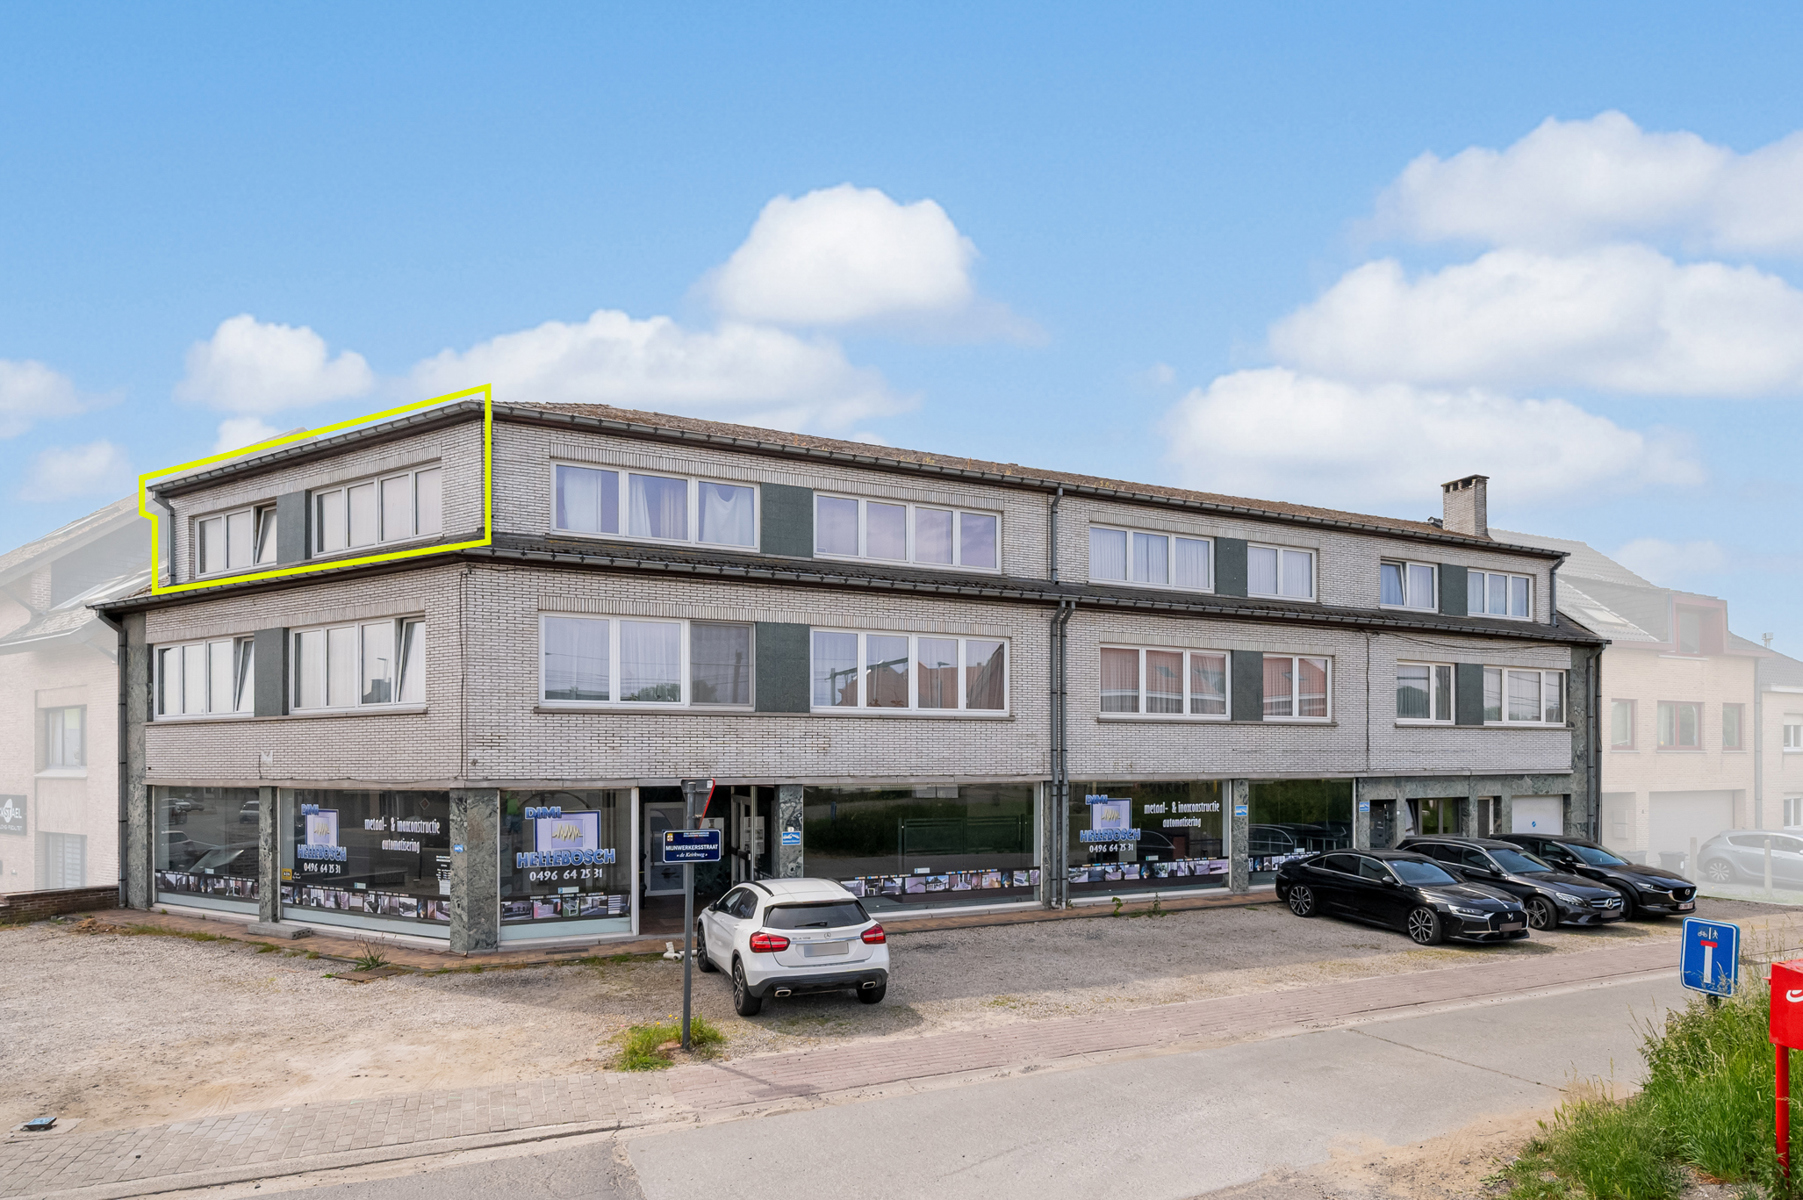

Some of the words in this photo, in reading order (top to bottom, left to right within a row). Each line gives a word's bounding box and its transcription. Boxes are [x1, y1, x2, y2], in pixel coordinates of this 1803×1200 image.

[1085, 795, 1108, 806] DIMI
[1144, 802, 1168, 814] metaal-
[1171, 801, 1177, 813] &
[1178, 800, 1220, 813] inoxconstructie
[301, 804, 319, 816] DIMI
[525, 806, 562, 820] DIMI
[364, 816, 387, 831] metaal-
[390, 816, 396, 832] &
[1162, 816, 1201, 828] automatisering
[1080, 828, 1141, 843] HELLEBOSCH
[297, 844, 347, 862] HELLEBOSCH
[381, 838, 420, 854] automatisering
[1089, 844, 1107, 853] 0496
[1109, 843, 1118, 852] 64
[1119, 843, 1127, 851] 25
[1127, 842, 1134, 851] 31
[516, 848, 616, 868] HELLEBOSCH
[303, 862, 318, 872] 0496
[320, 863, 328, 873] 64
[329, 864, 335, 874] 25
[335, 864, 341, 874] 31
[529, 870, 558, 881] 0496
[563, 869, 577, 880] 64
[580, 868, 591, 879] 25
[593, 868, 603, 879] 31
